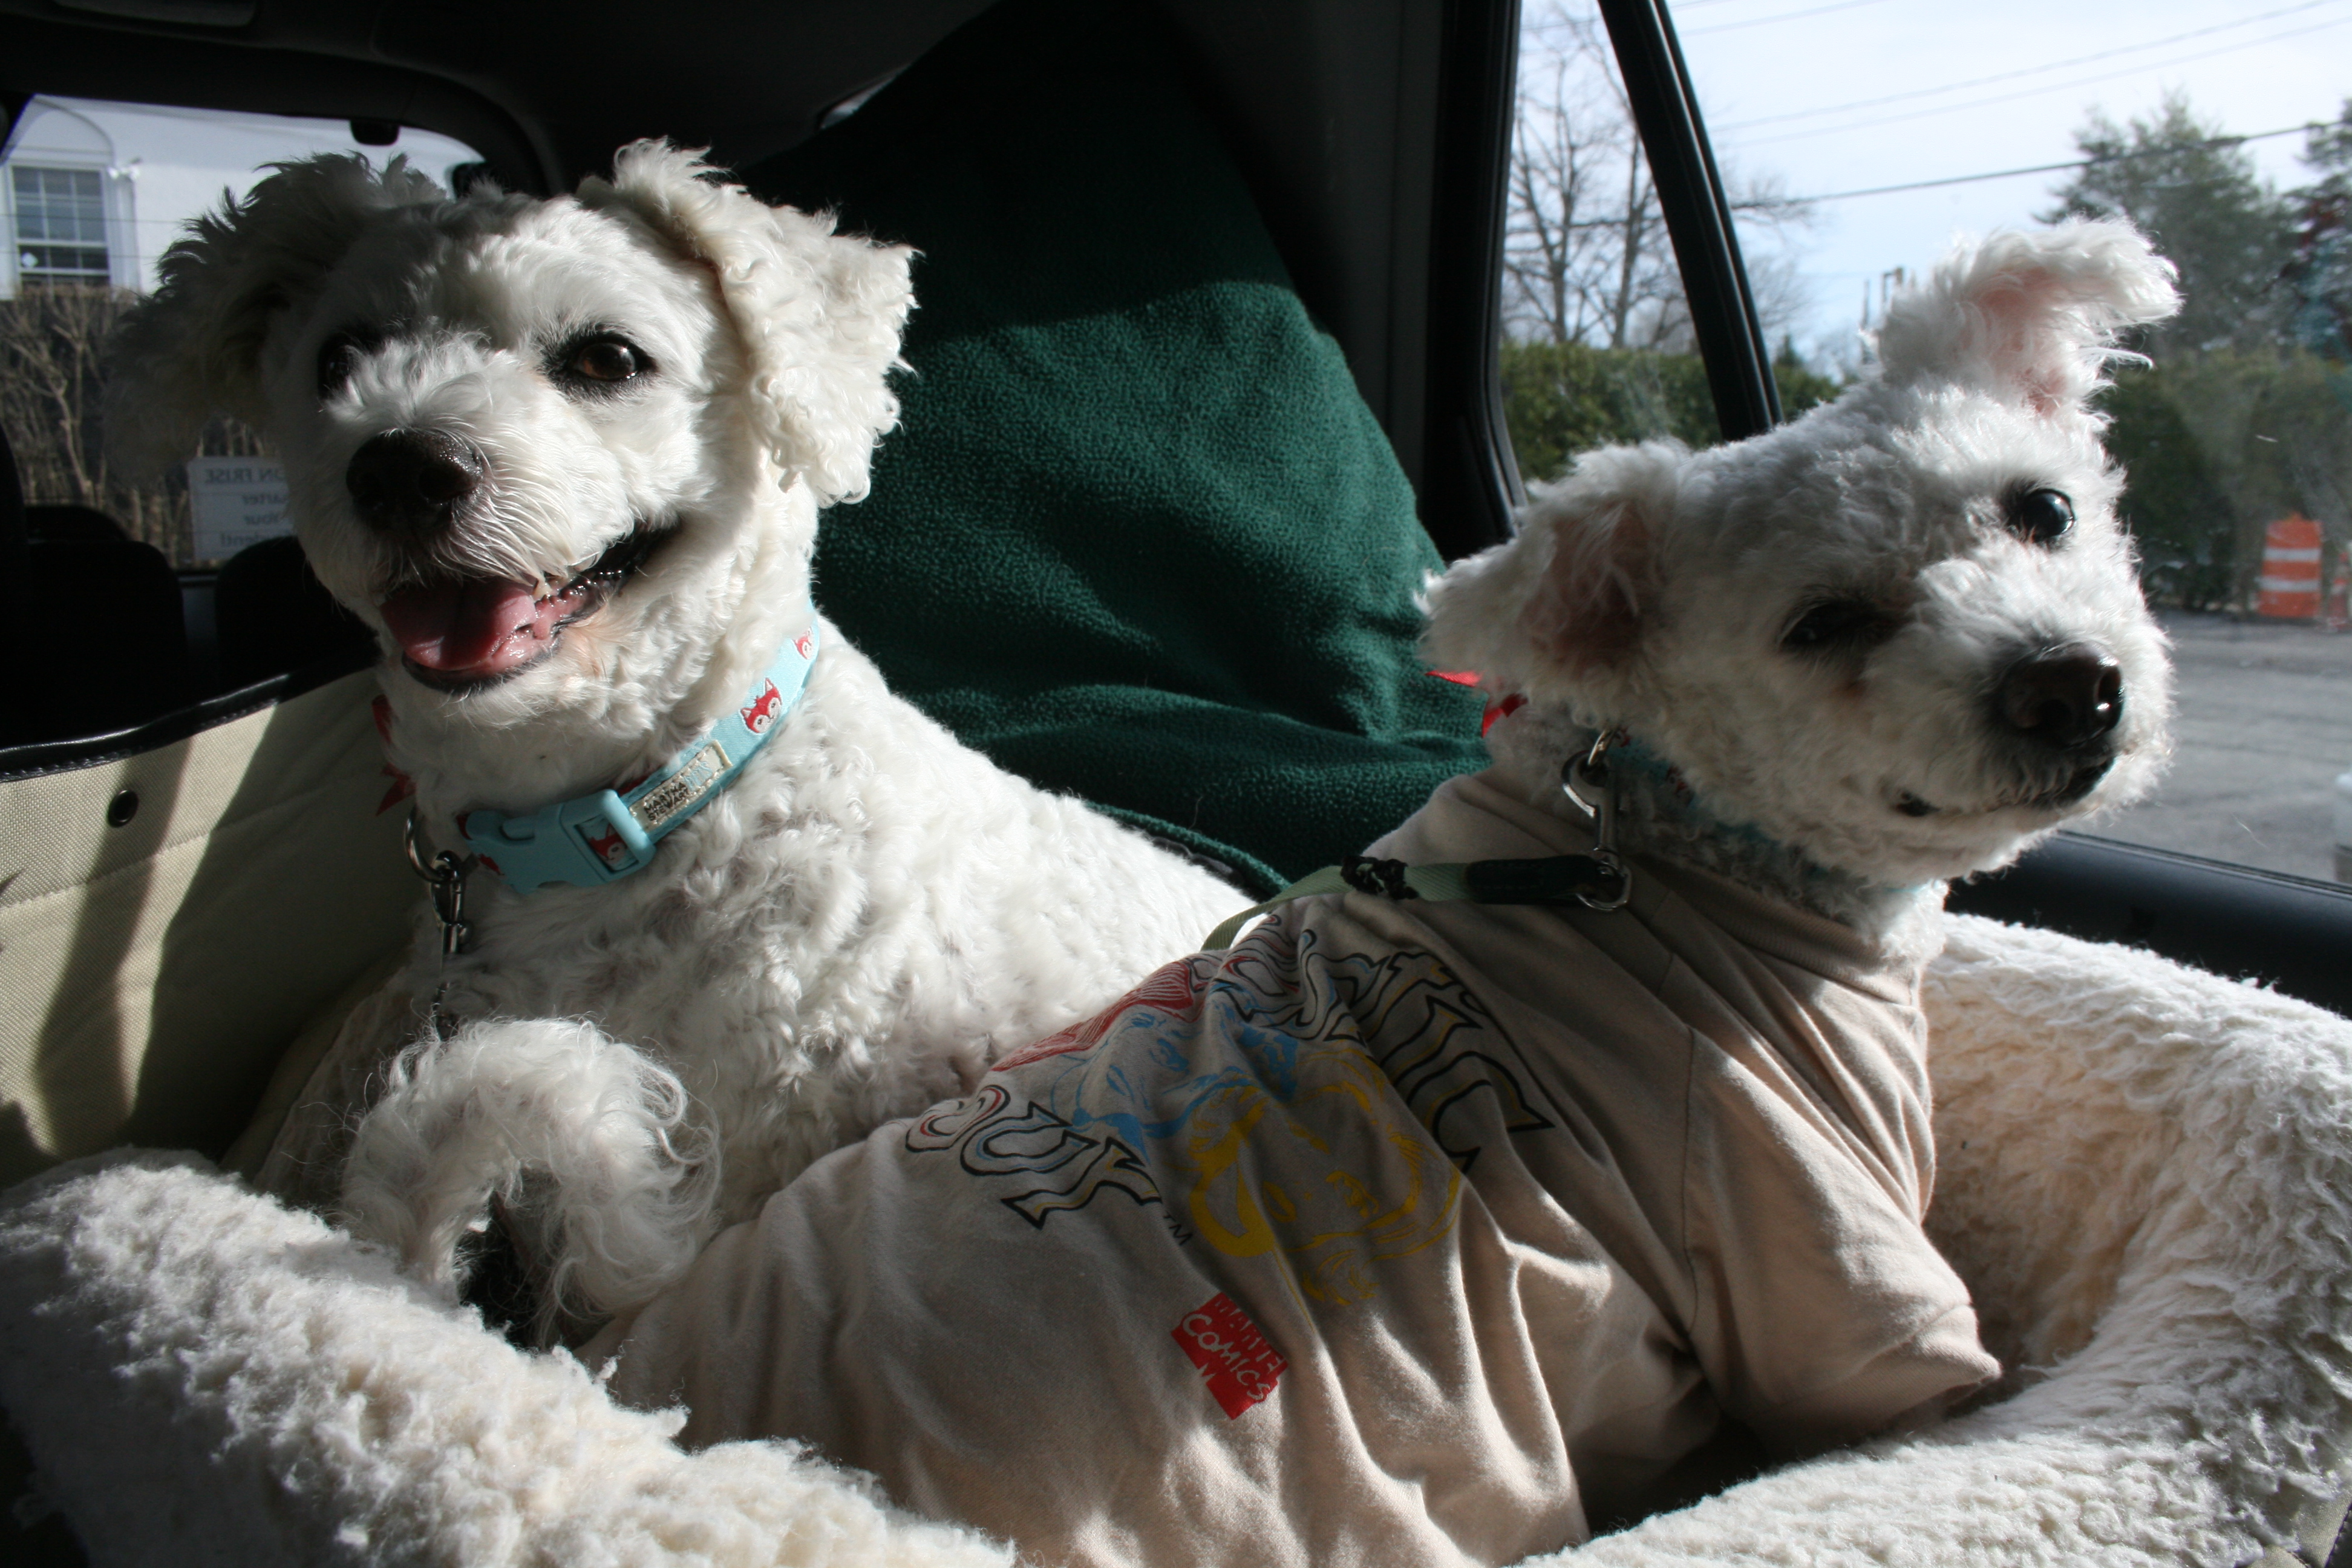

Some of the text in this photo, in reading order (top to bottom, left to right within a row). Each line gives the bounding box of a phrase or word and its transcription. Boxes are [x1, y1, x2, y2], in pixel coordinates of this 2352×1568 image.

[643, 782, 686, 814] MARTHA
[647, 788, 690, 822] STEWART
[906, 1084, 1163, 1230] our
[1182, 1313, 1270, 1400] COMICS
[1210, 1292, 1289, 1385] MARVEL
